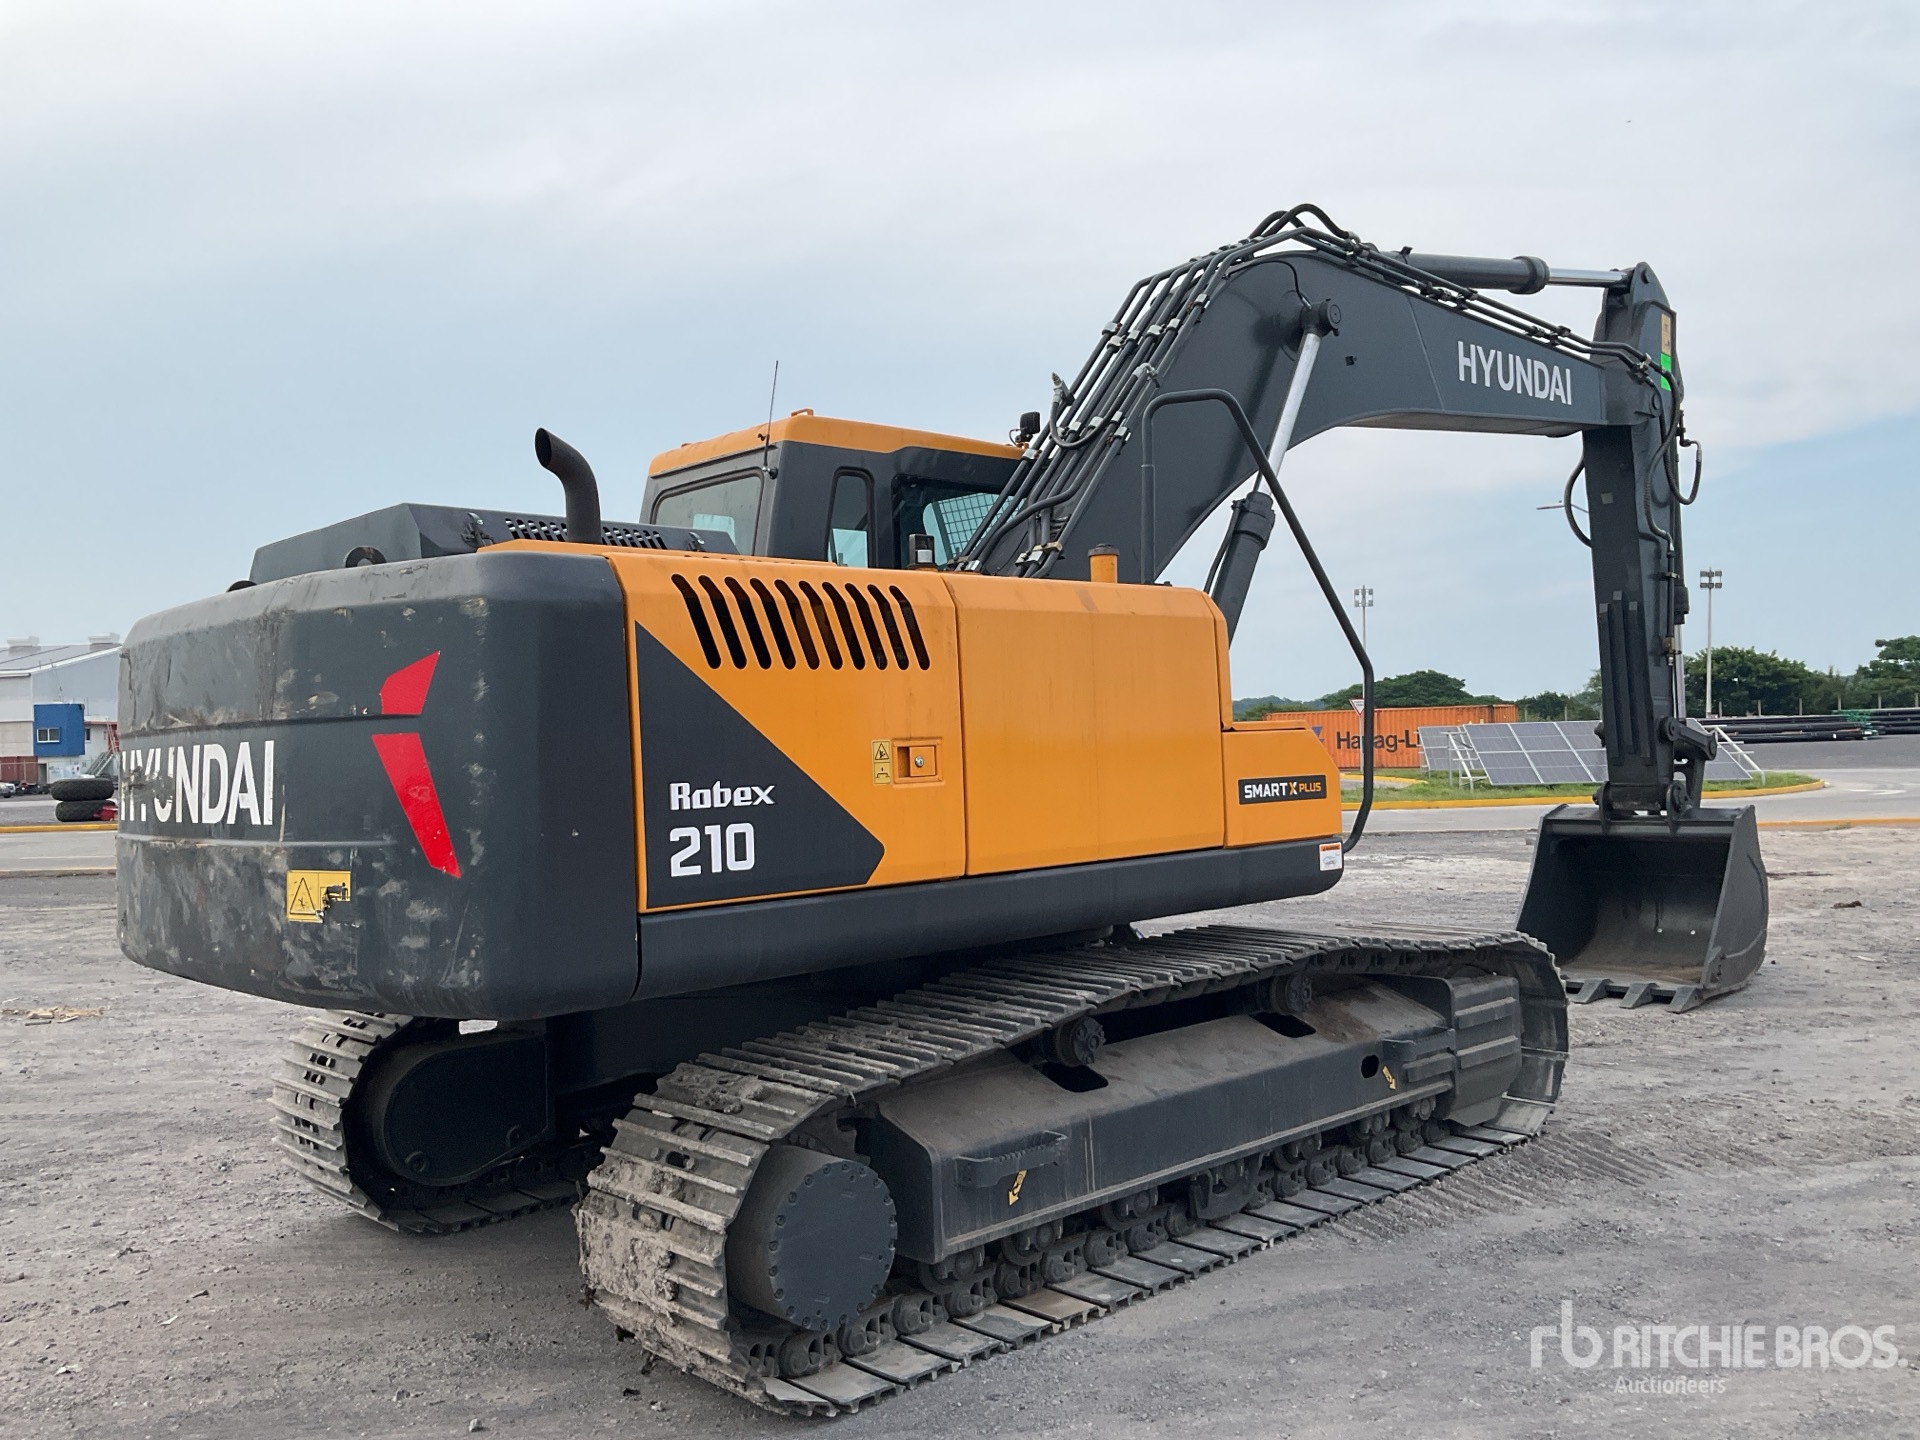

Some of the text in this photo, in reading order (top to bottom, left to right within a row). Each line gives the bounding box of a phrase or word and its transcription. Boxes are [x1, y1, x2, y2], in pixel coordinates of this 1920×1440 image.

[1458, 340, 1572, 405] HYUNDAI
[669, 780, 776, 811] Robex
[1244, 782, 1288, 799] SMART
[1298, 782, 1322, 793] PLUS
[669, 822, 755, 878] 210
